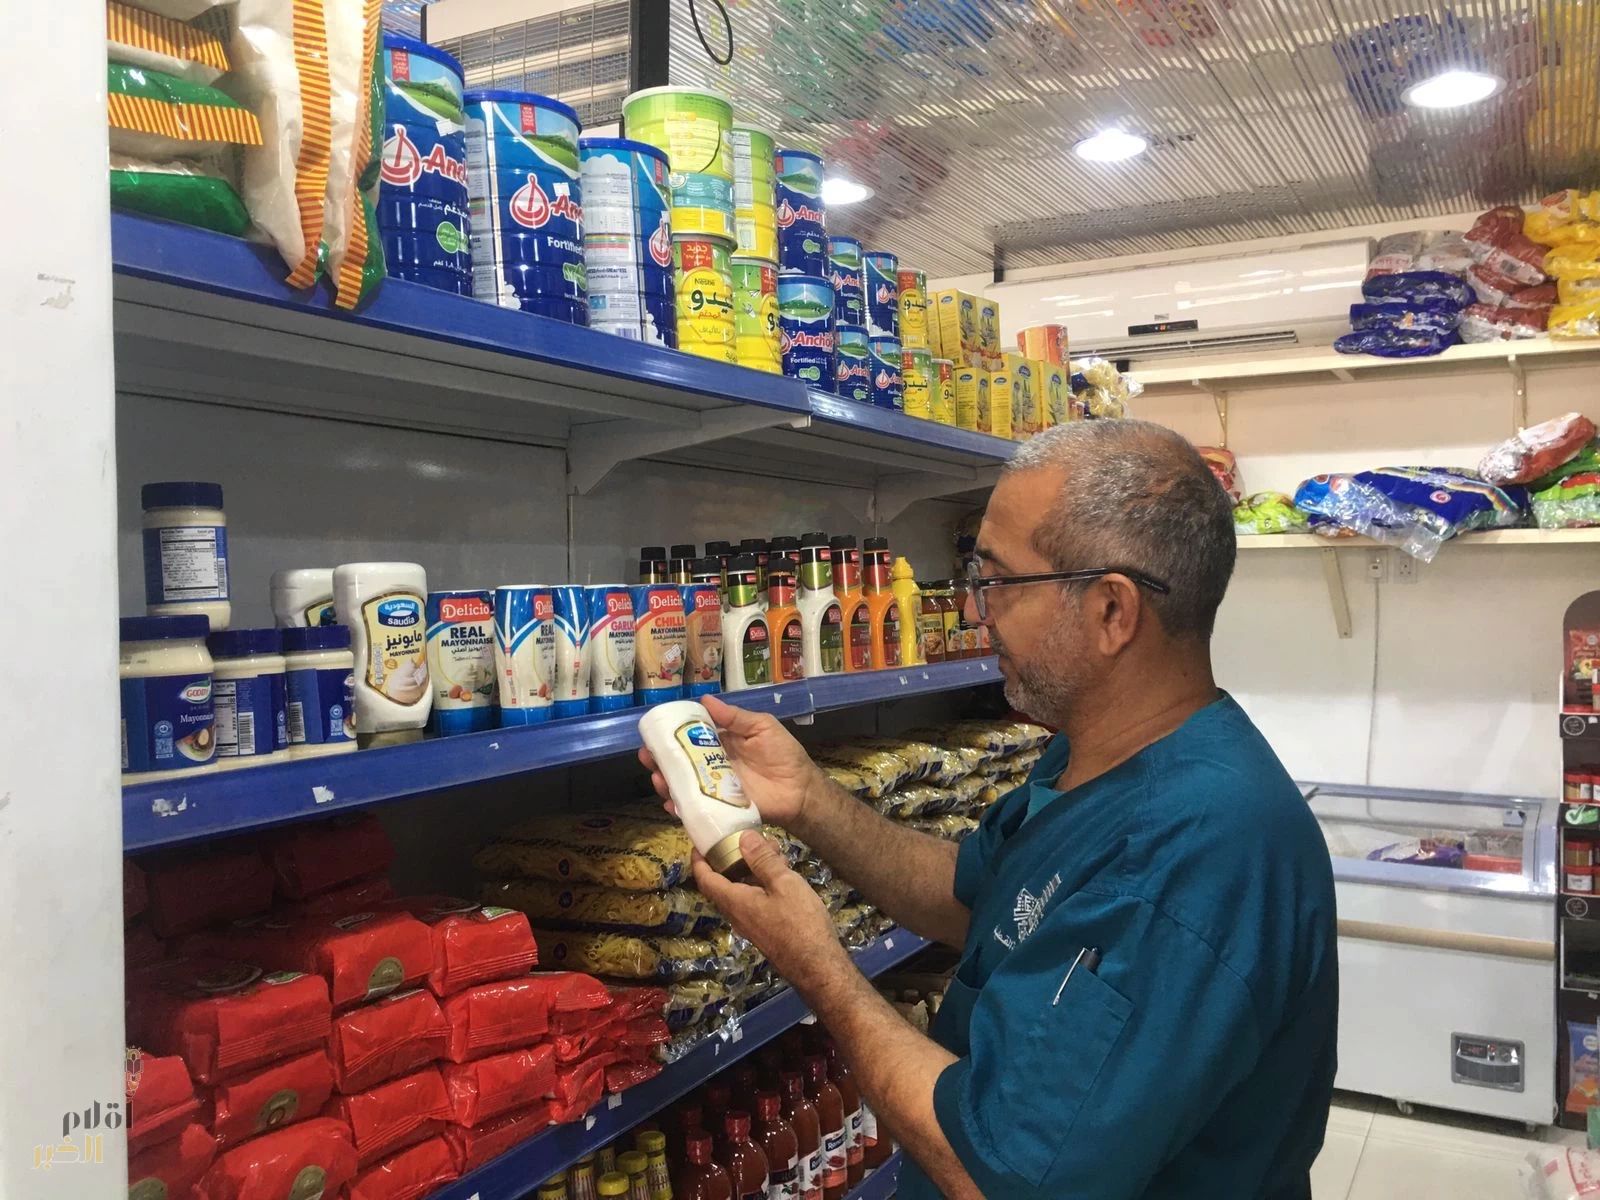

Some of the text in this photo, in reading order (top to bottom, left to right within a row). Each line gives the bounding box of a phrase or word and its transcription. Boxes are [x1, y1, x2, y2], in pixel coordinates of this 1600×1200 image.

[442, 603, 490, 618] Delicio
[655, 616, 684, 627] CHILLI
[450, 625, 486, 640] REAL
[540, 624, 555, 637] REAL
[385, 629, 423, 651] مايونيز
[441, 636, 494, 648] MAYONNAISE
